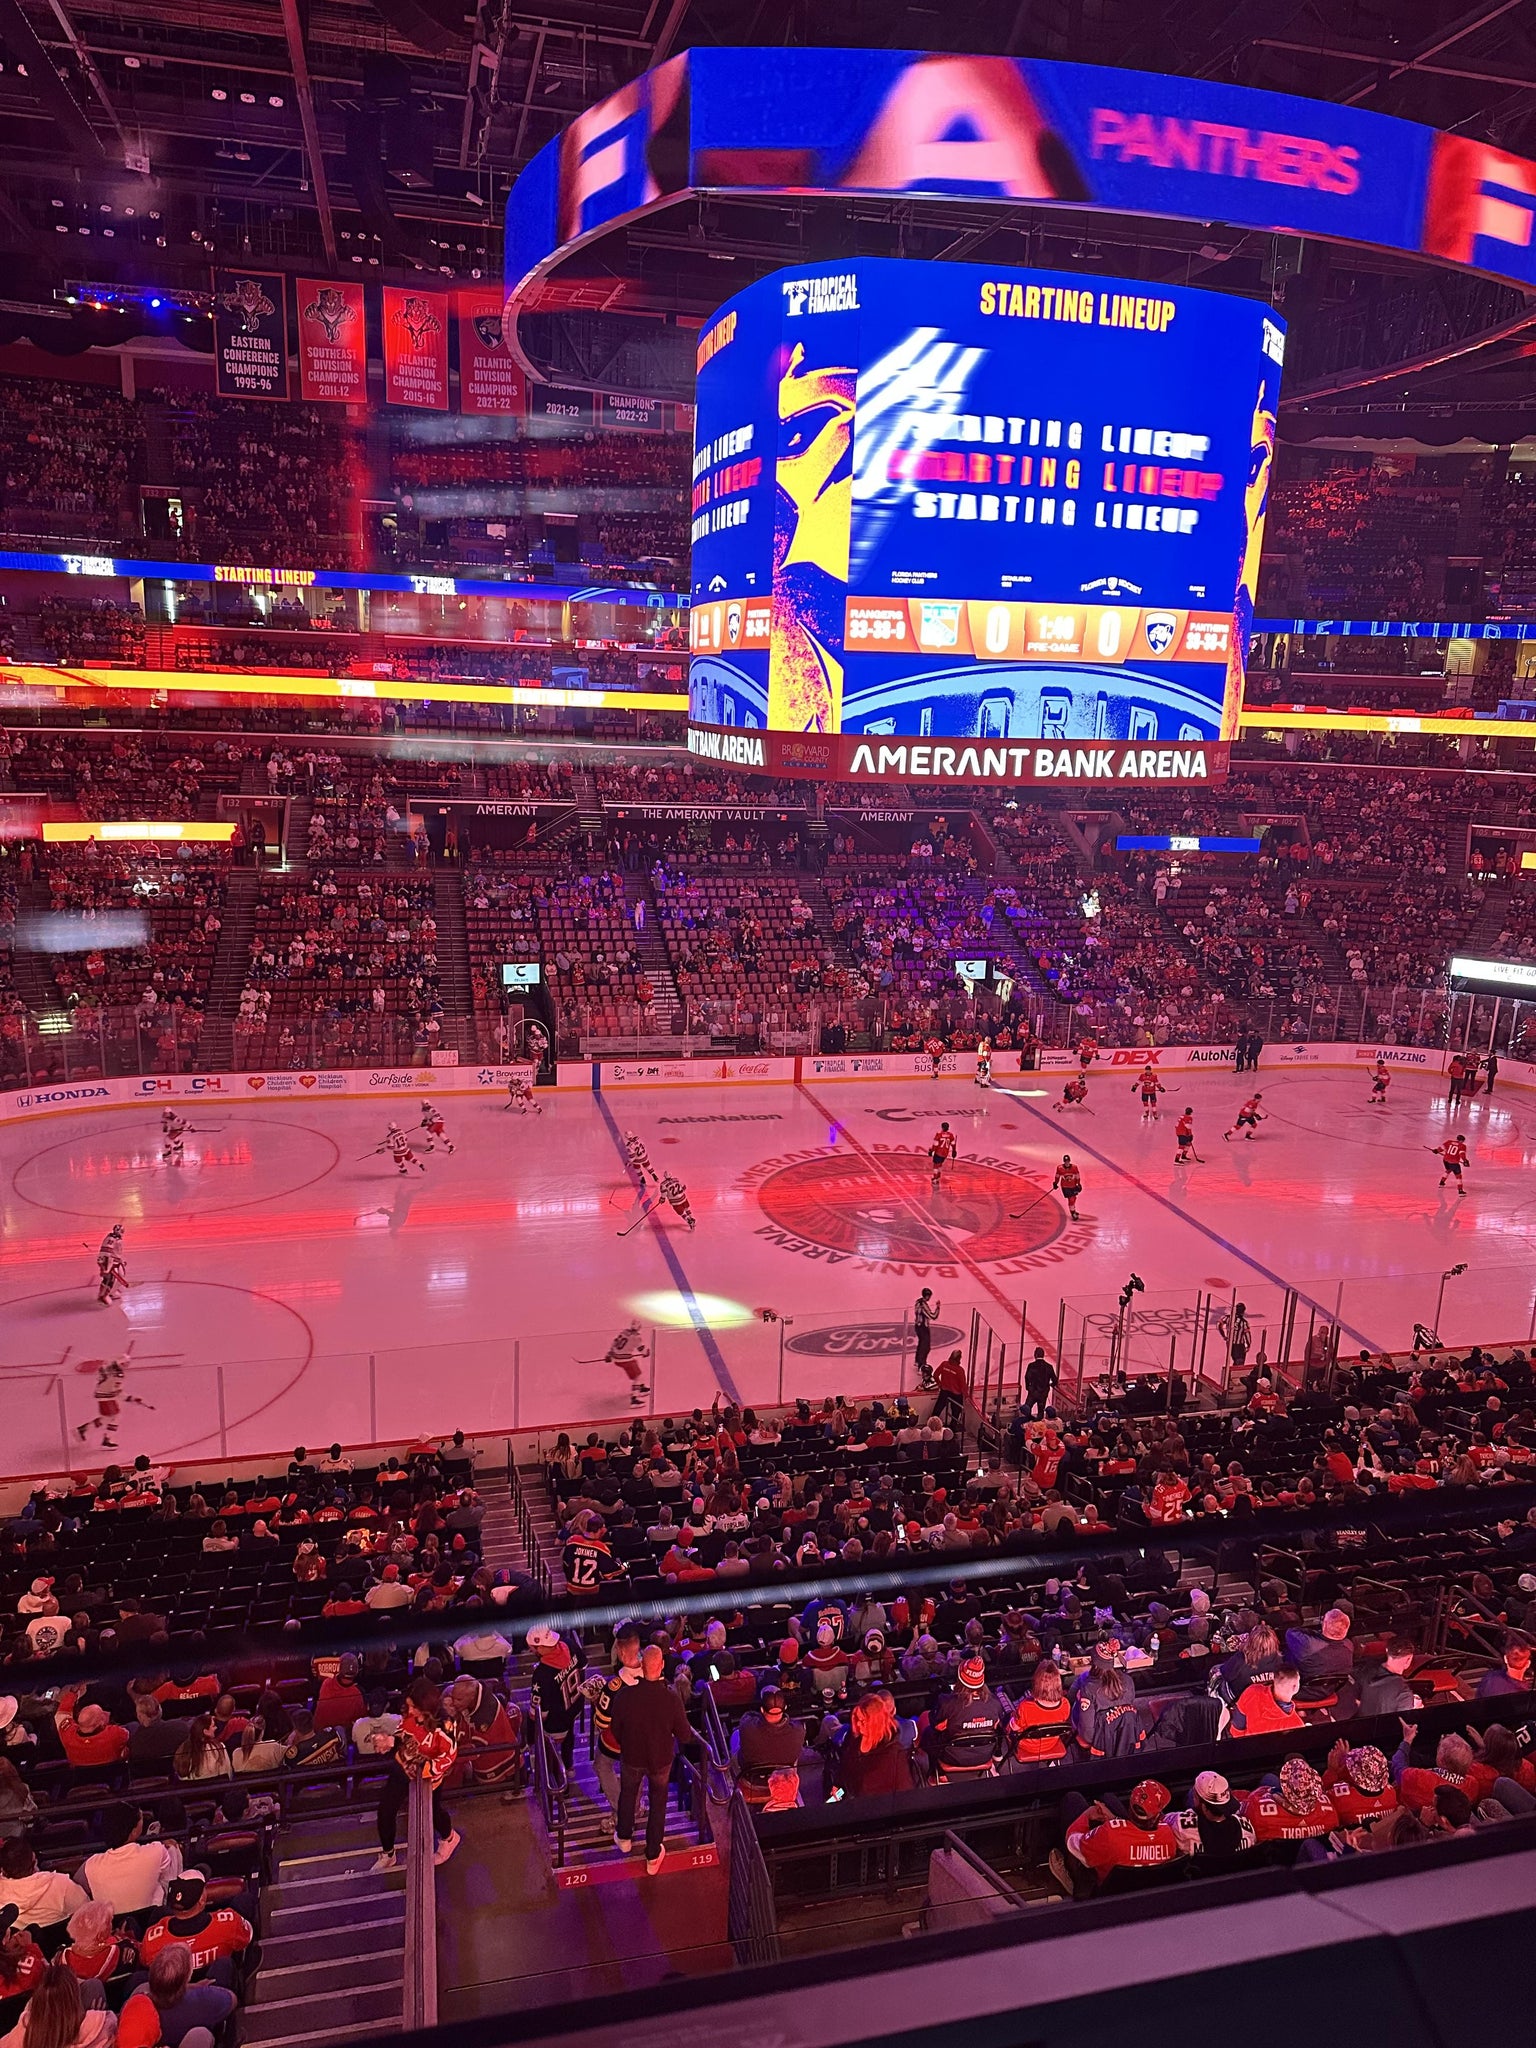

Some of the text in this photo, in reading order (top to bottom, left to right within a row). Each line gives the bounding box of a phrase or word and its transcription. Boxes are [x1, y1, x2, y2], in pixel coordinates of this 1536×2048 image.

[1090, 107, 1361, 196] PANTHERS
[809, 274, 858, 296] TROPICAL
[808, 292, 861, 314] FINANCIAL
[979, 282, 1176, 333] STARTING LINEUP
[231, 335, 271, 350] EASTERN
[223, 348, 280, 364] CONFERENCE
[307, 346, 357, 359] SOUTHEAST
[313, 359, 352, 371] DIVISION
[398, 354, 437, 368] ATLANTIC
[473, 357, 512, 369] ATLANTIC
[225, 362, 279, 378] CHAMPIONS
[399, 365, 435, 379] DIVISION
[474, 370, 512, 383] DIVISION
[234, 376, 272, 390] 1995-96
[308, 372, 360, 384] CHAMPIONS
[393, 376, 442, 392] CHAMPIONS
[319, 384, 350, 397] 2011-12
[468, 382, 518, 396] CHAMPIONS
[403, 390, 435, 404] 2015-16
[477, 396, 511, 409] 2021-22
[609, 395, 655, 411] CHAMPIONS
[546, 403, 579, 417] 2021-22
[615, 409, 649, 423] 2022-23
[1101, 425, 1211, 461] LINEUP
[1103, 462, 1224, 501] LINEUP
[913, 492, 1199, 534] STARTING LINEUP
[213, 565, 316, 586] STARTING LINEUP
[849, 608, 904, 620] RANGERS
[985, 605, 1011, 654] 0
[1098, 610, 1122, 657] 0
[1189, 622, 1230, 634] PANTHERS
[1027, 642, 1080, 653] PRE-GAME
[700, 732, 722, 760] BANK
[721, 734, 764, 767] ARENA
[782, 761, 828, 769] FLORIDA
[804, 756, 830, 764] COUNTY
[849, 744, 1208, 779] AMERANT BANK ARENA
[226, 798, 240, 808] 132
[476, 805, 539, 816] AMERANT
[641, 808, 767, 821] THE AMERANT VAULT
[859, 811, 914, 823] AMERANT
[1493, 964, 1510, 974] LIVE
[1513, 966, 1524, 976] FIT
[914, 1055, 957, 1064] COMAST
[1111, 1050, 1163, 1065] DEX
[1376, 1050, 1427, 1063] AMAZING
[914, 1064, 957, 1072] BUSNESS
[369, 1072, 413, 1088] Surfside
[34, 1087, 111, 1104] HONDA
[657, 1113, 783, 1124] AutoNation
[912, 1107, 990, 1118] CELSIUS
[1446, 1144, 1458, 1155] 10
[731, 1146, 846, 1191] AMERANT
[963, 1153, 1051, 1184] ARENA
[669, 1184, 682, 1197] 22
[752, 1224, 853, 1265] ARENA
[853, 1260, 960, 1279] BANK
[574, 1547, 598, 1558] JOKINEN
[572, 1557, 597, 1585] 12
[318, 1662, 341, 1672] BOBROV
[962, 1719, 993, 1729] PANTHERS
[421, 1731, 434, 1748] A
[691, 1853, 714, 1866] 119
[1129, 1844, 1171, 1861] LUNDELL
[565, 1873, 588, 1887] 120
